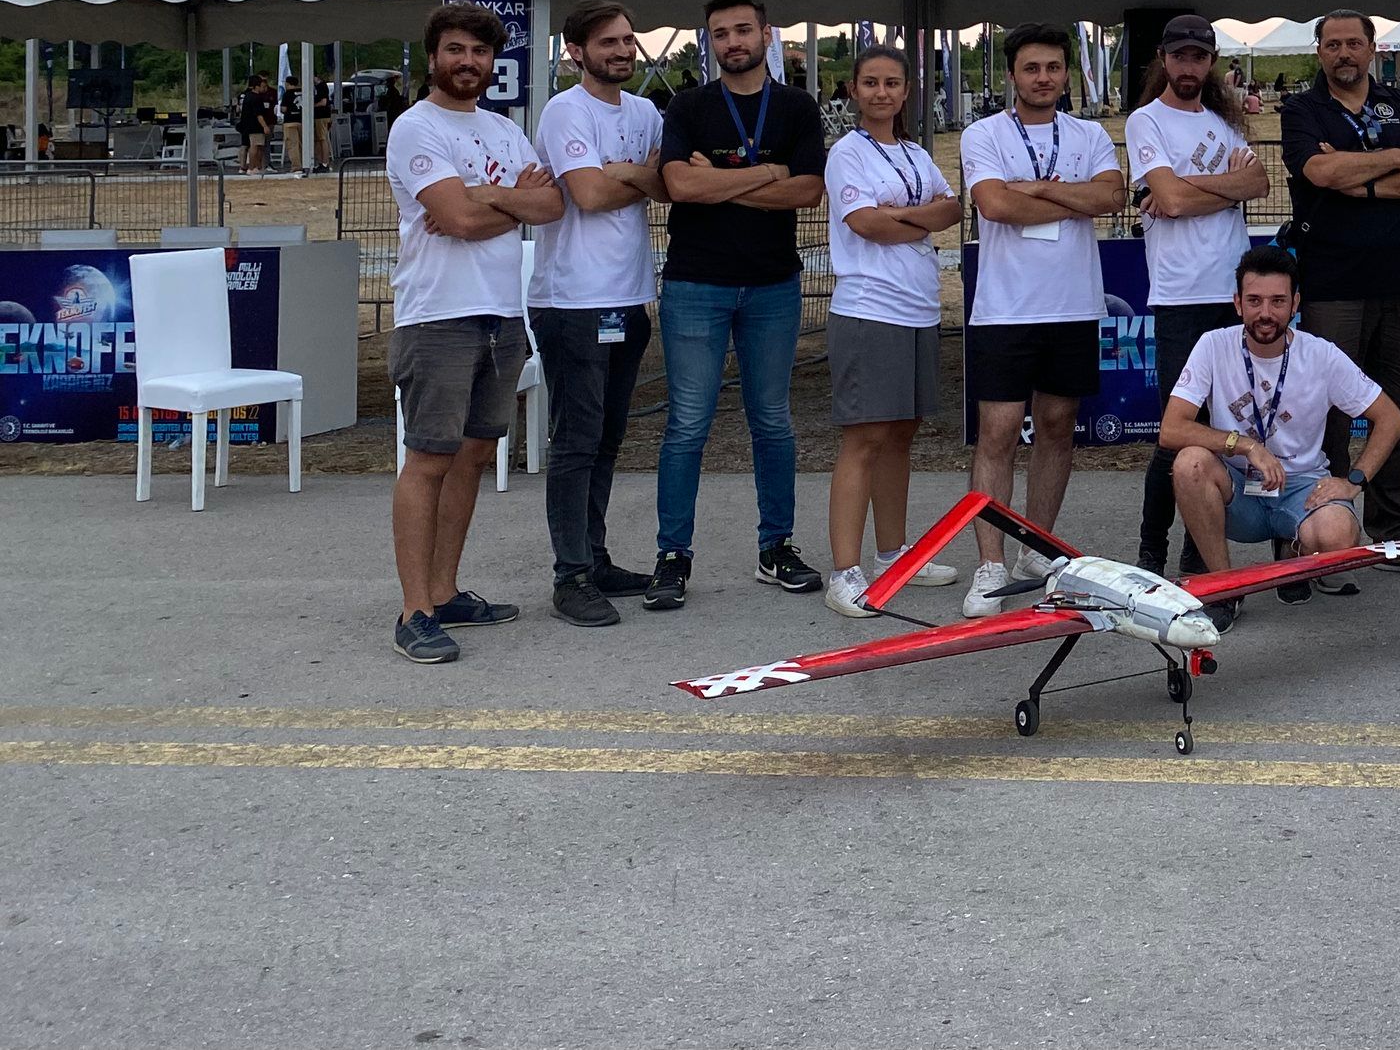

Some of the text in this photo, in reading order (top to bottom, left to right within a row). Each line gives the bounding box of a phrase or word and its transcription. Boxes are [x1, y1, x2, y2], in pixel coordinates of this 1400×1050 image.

[485, 58, 519, 100] 3
[0, 322, 136, 374] EKNOFE
[118, 406, 129, 420] 15
